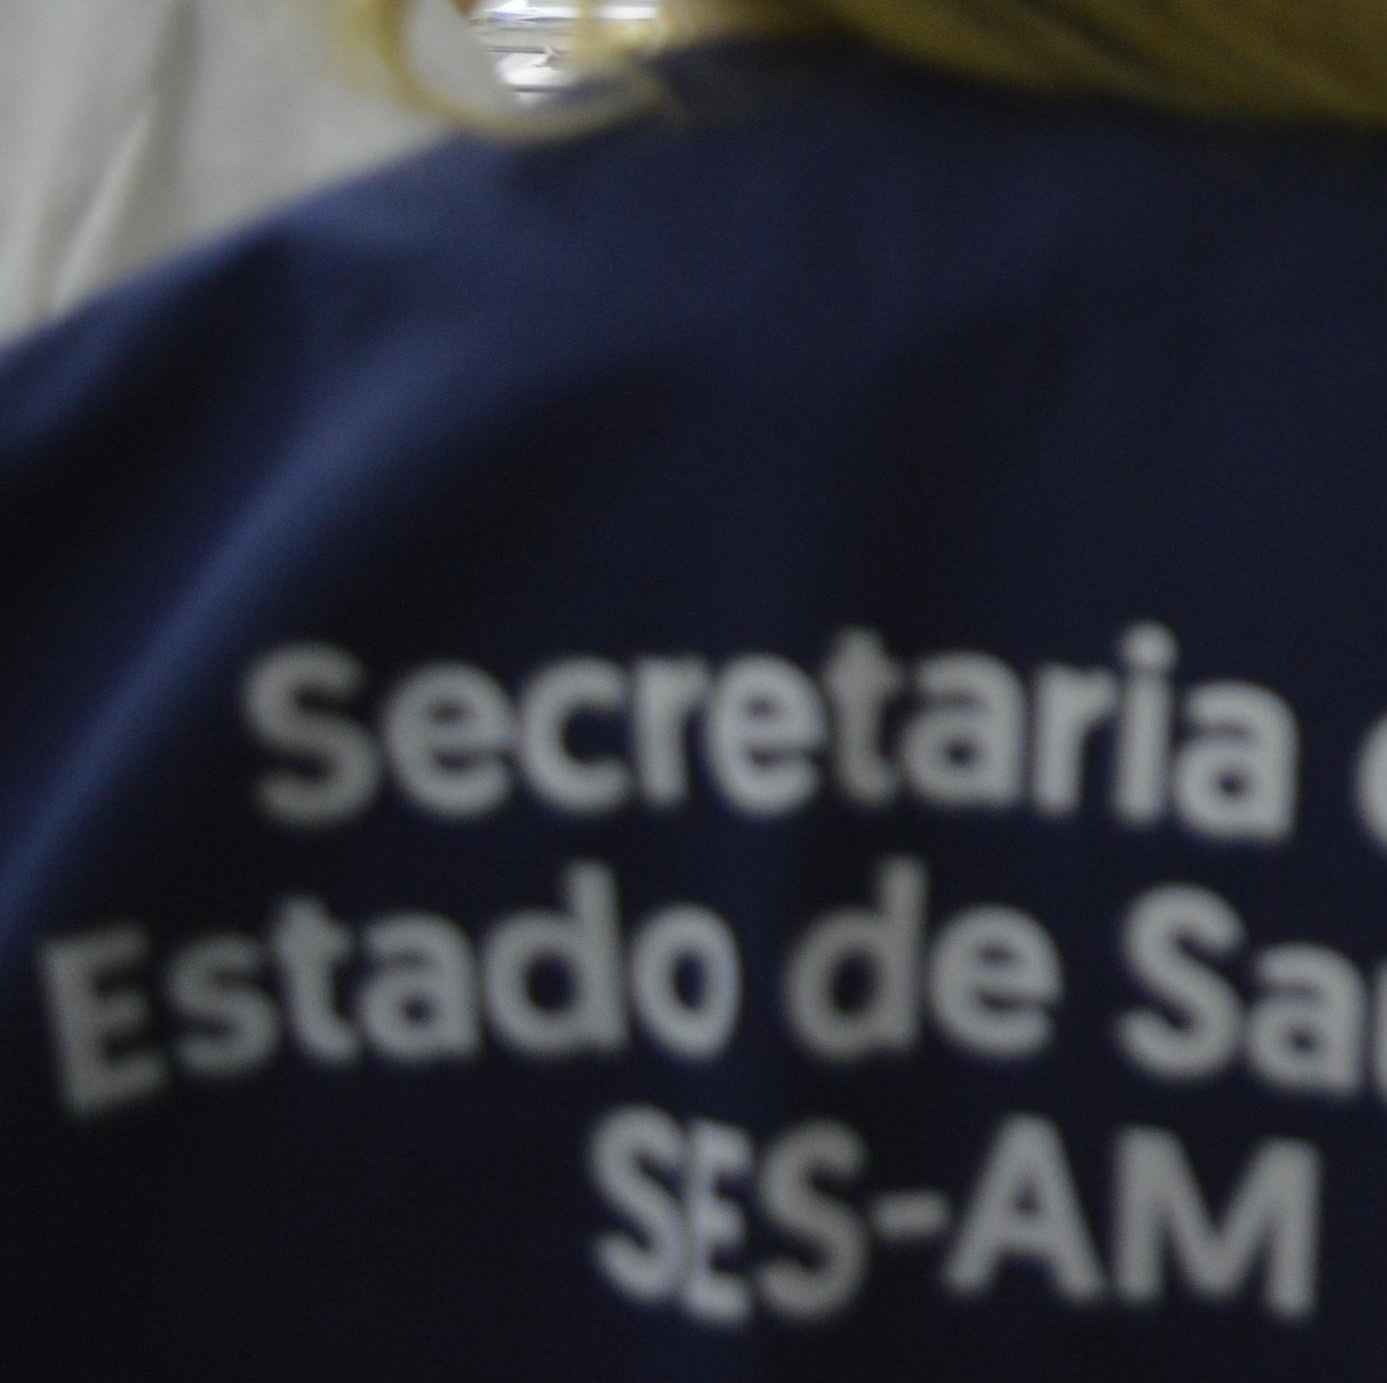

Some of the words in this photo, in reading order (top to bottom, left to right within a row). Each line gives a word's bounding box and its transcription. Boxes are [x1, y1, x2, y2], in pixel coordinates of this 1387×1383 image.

[244, 625, 1298, 839] Secretaria
[40, 863, 741, 1109] Estado
[787, 860, 1061, 1058] de
[592, 1107, 1319, 1324] SES-AM
